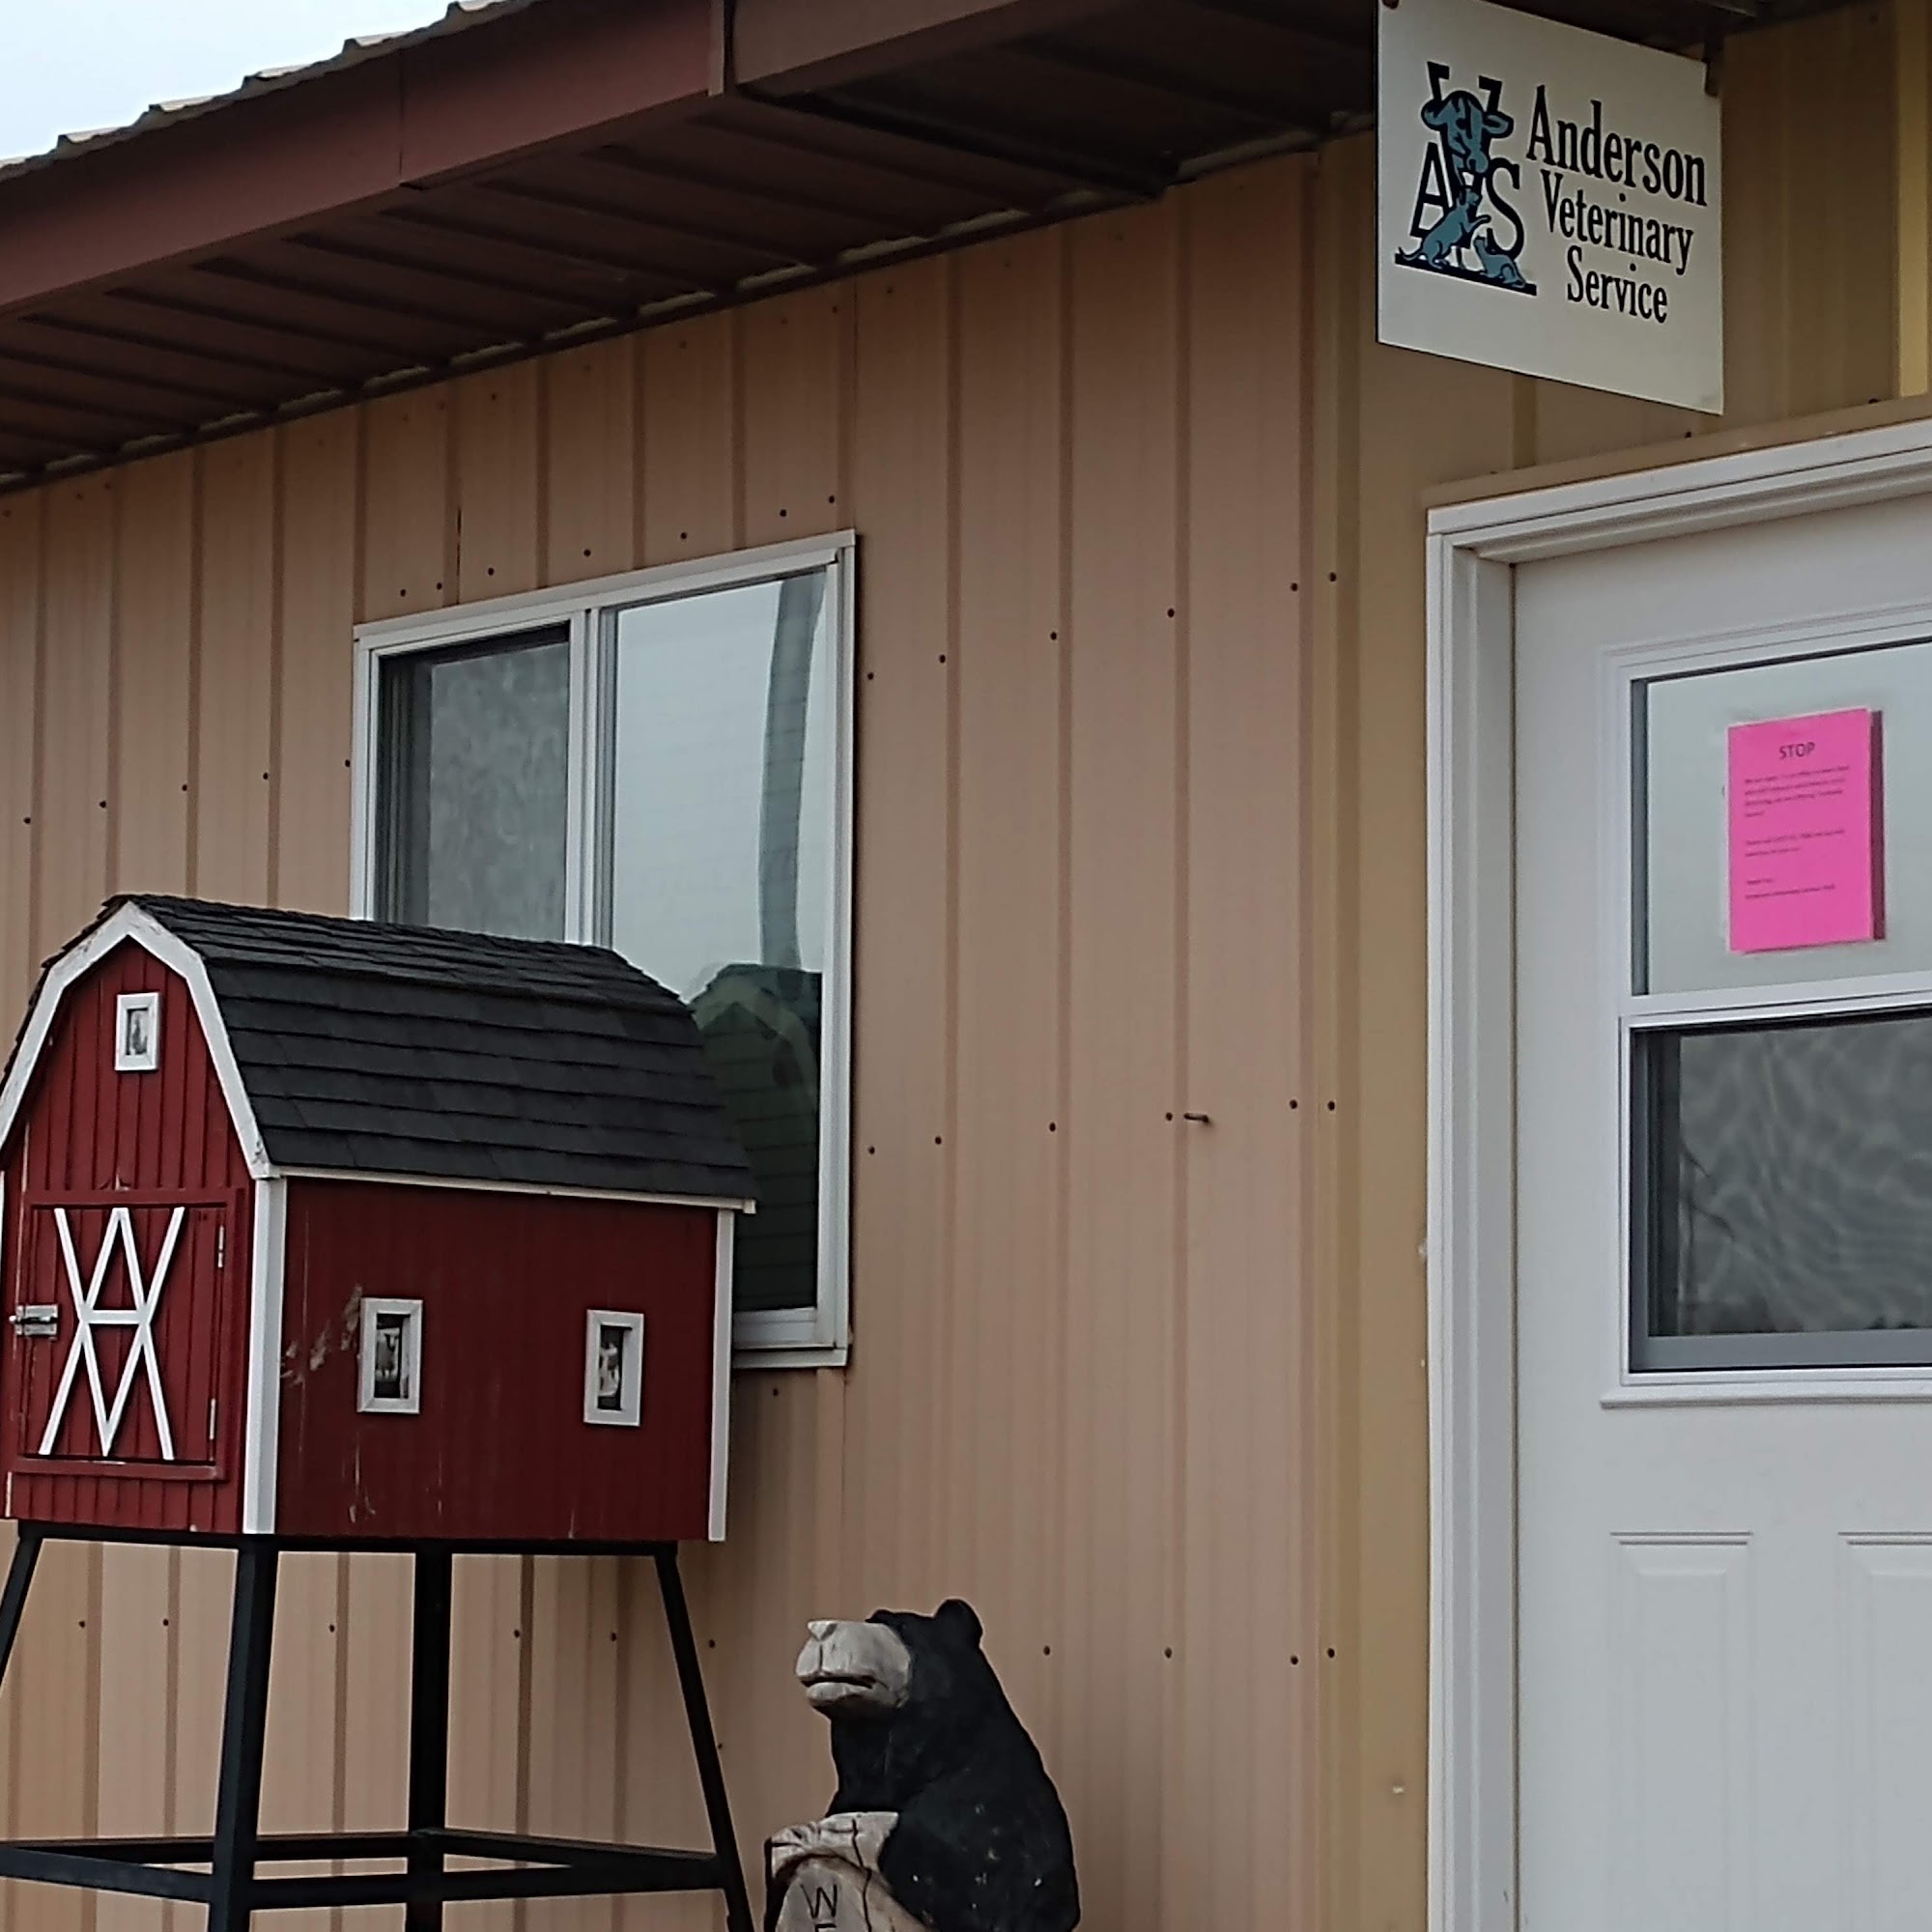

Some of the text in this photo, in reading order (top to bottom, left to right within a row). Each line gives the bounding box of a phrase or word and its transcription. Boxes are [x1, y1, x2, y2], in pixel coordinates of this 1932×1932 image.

[1526, 85, 1708, 207] Anderson
[1541, 168, 1693, 276] Veterinary
[1567, 245, 1667, 324] Service
[1779, 742, 1815, 759] STOP
